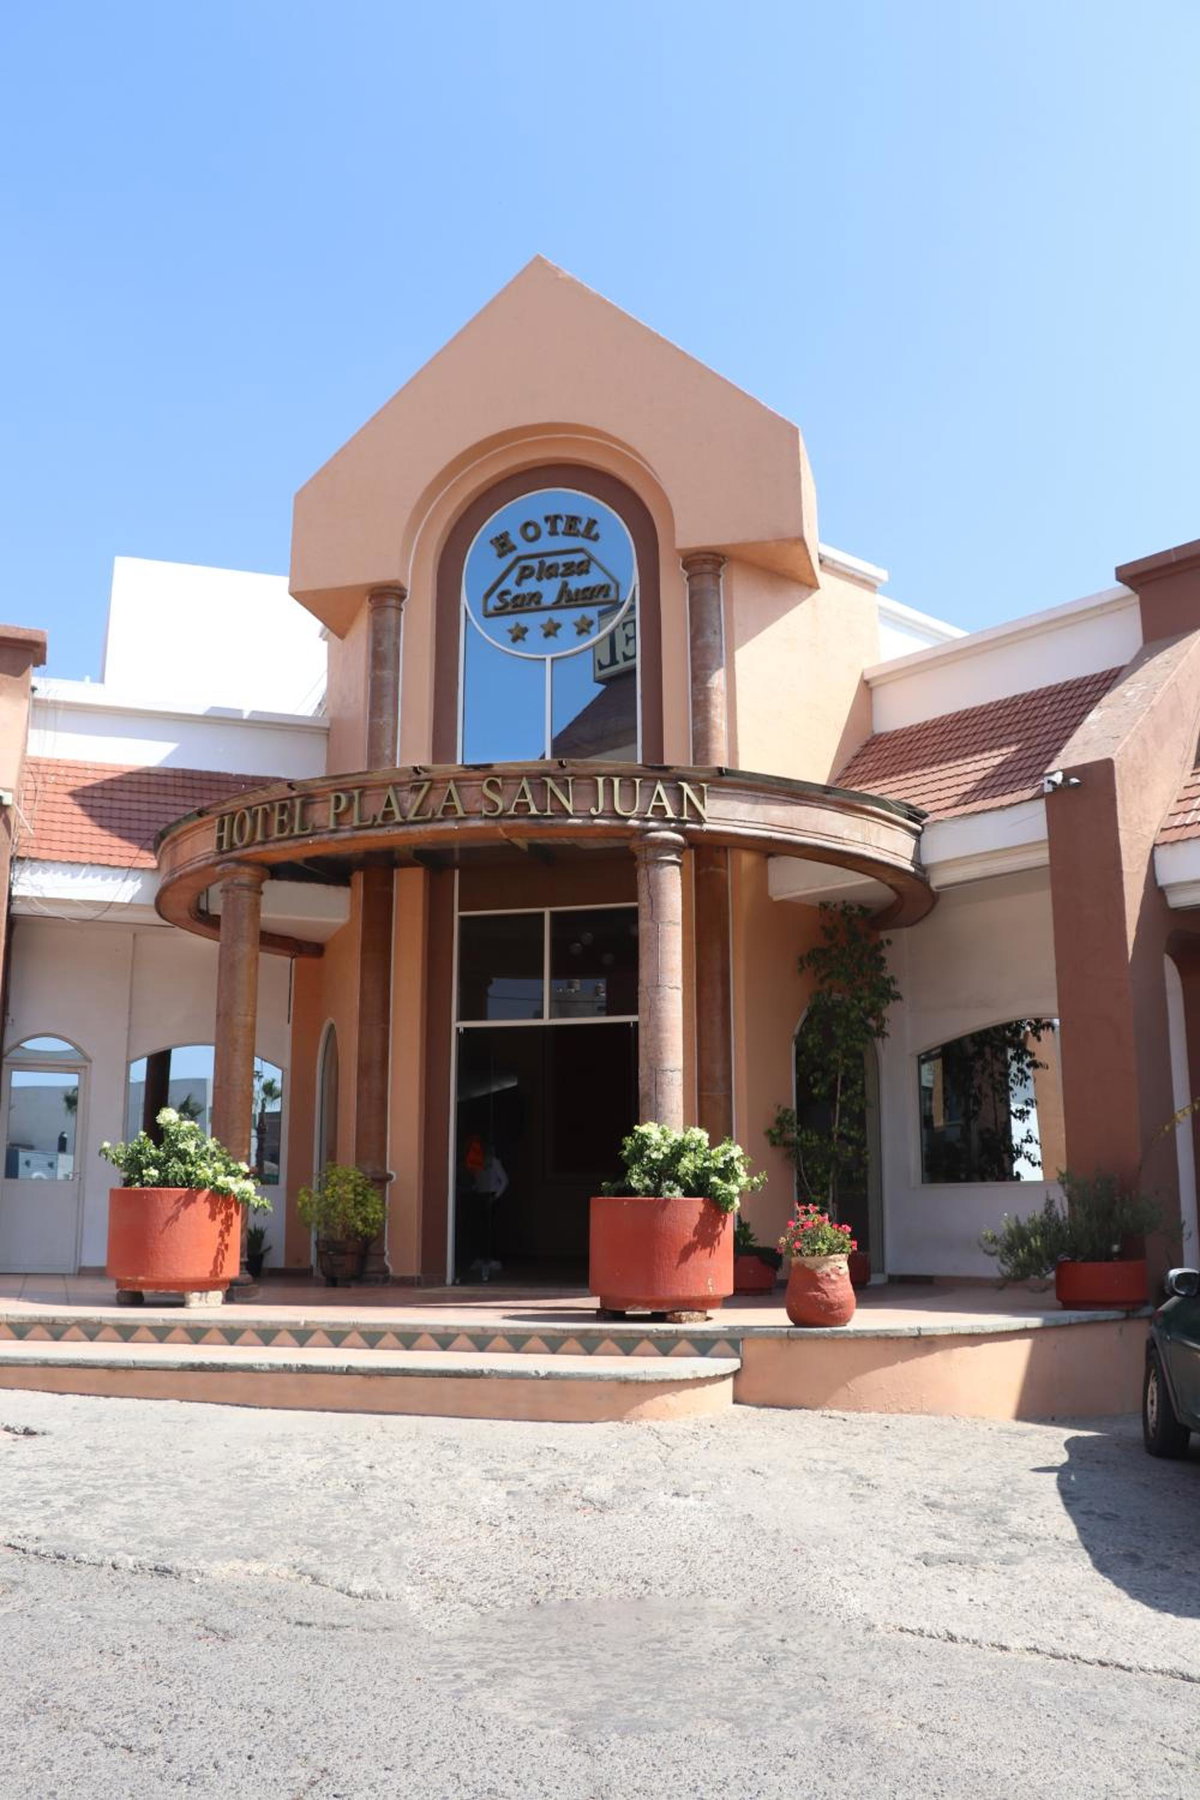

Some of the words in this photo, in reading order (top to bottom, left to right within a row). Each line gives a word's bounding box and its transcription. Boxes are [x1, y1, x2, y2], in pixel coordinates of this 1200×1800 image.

[489, 513, 600, 559] HOTEL
[493, 589, 543, 611] San
[214, 798, 312, 852] HOTEL
[327, 779, 467, 831] PLAZA
[481, 776, 575, 817] SAN
[589, 776, 711, 823] JUAN
